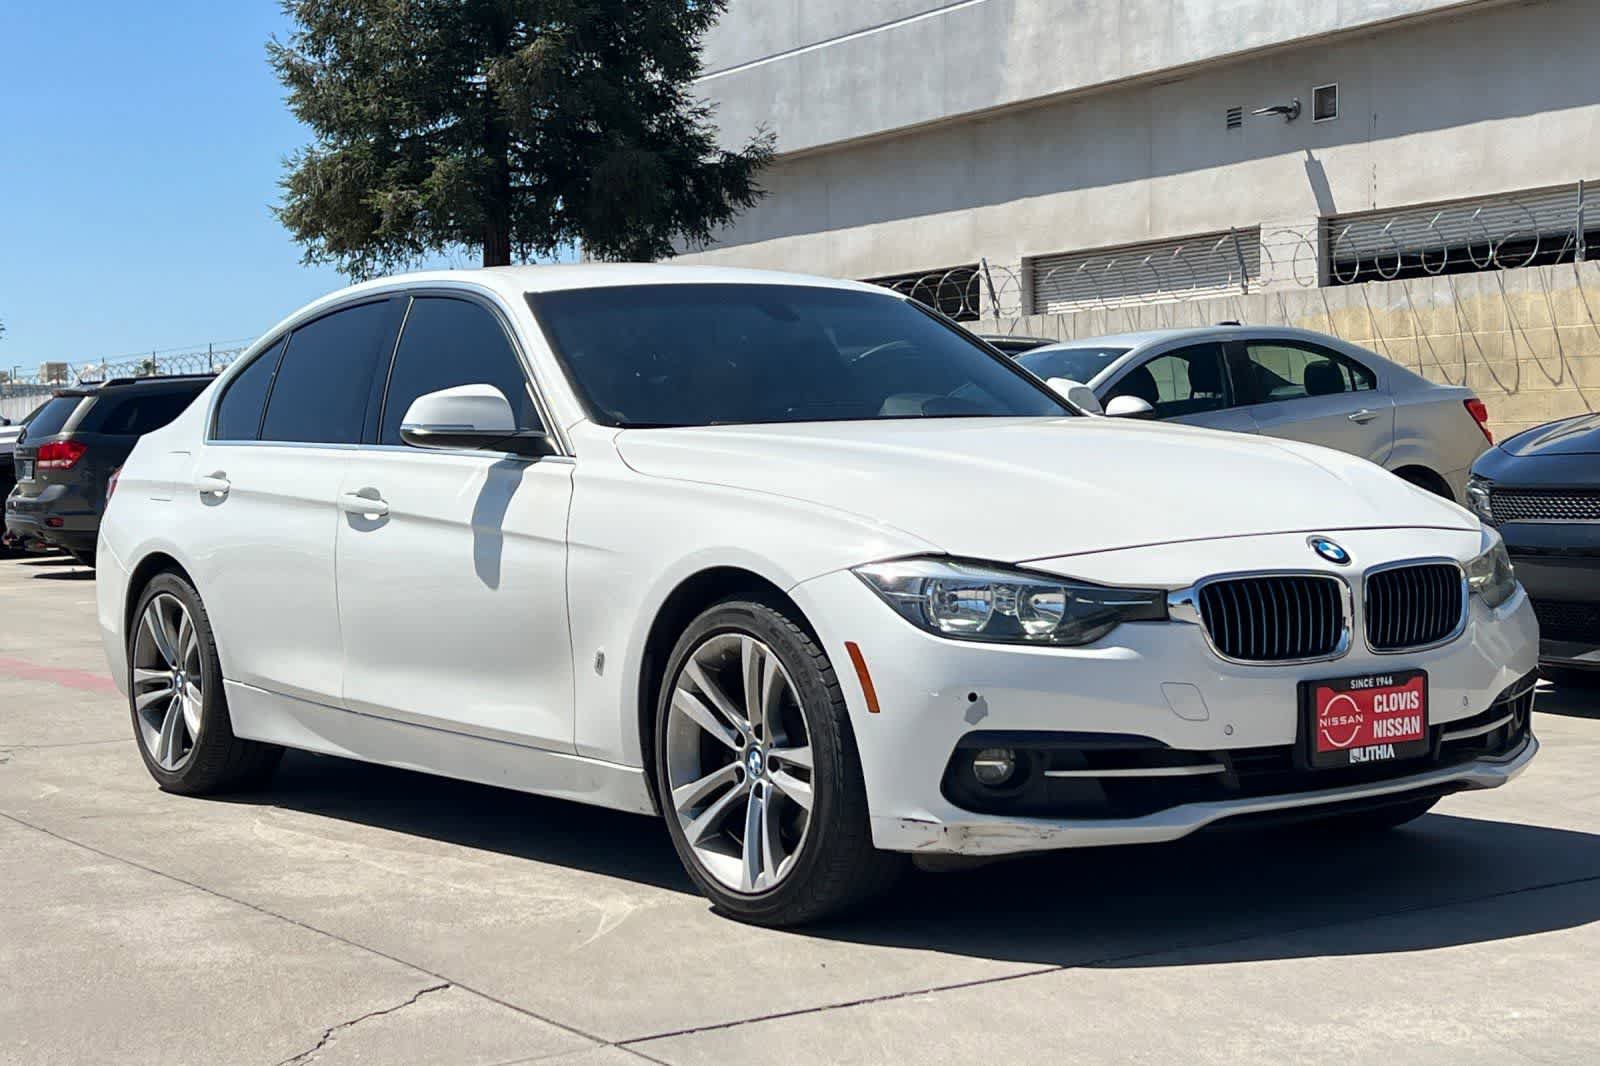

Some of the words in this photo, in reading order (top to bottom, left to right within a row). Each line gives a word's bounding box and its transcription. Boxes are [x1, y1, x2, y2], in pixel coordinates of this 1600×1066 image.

[1350, 678, 1374, 689] SINCE
[1376, 675, 1393, 686] 1946
[1373, 690, 1419, 713] CLOVIS
[1320, 714, 1363, 728] NISSAN
[1373, 715, 1420, 738] NISSAN
[1360, 744, 1395, 762] LITHIA
